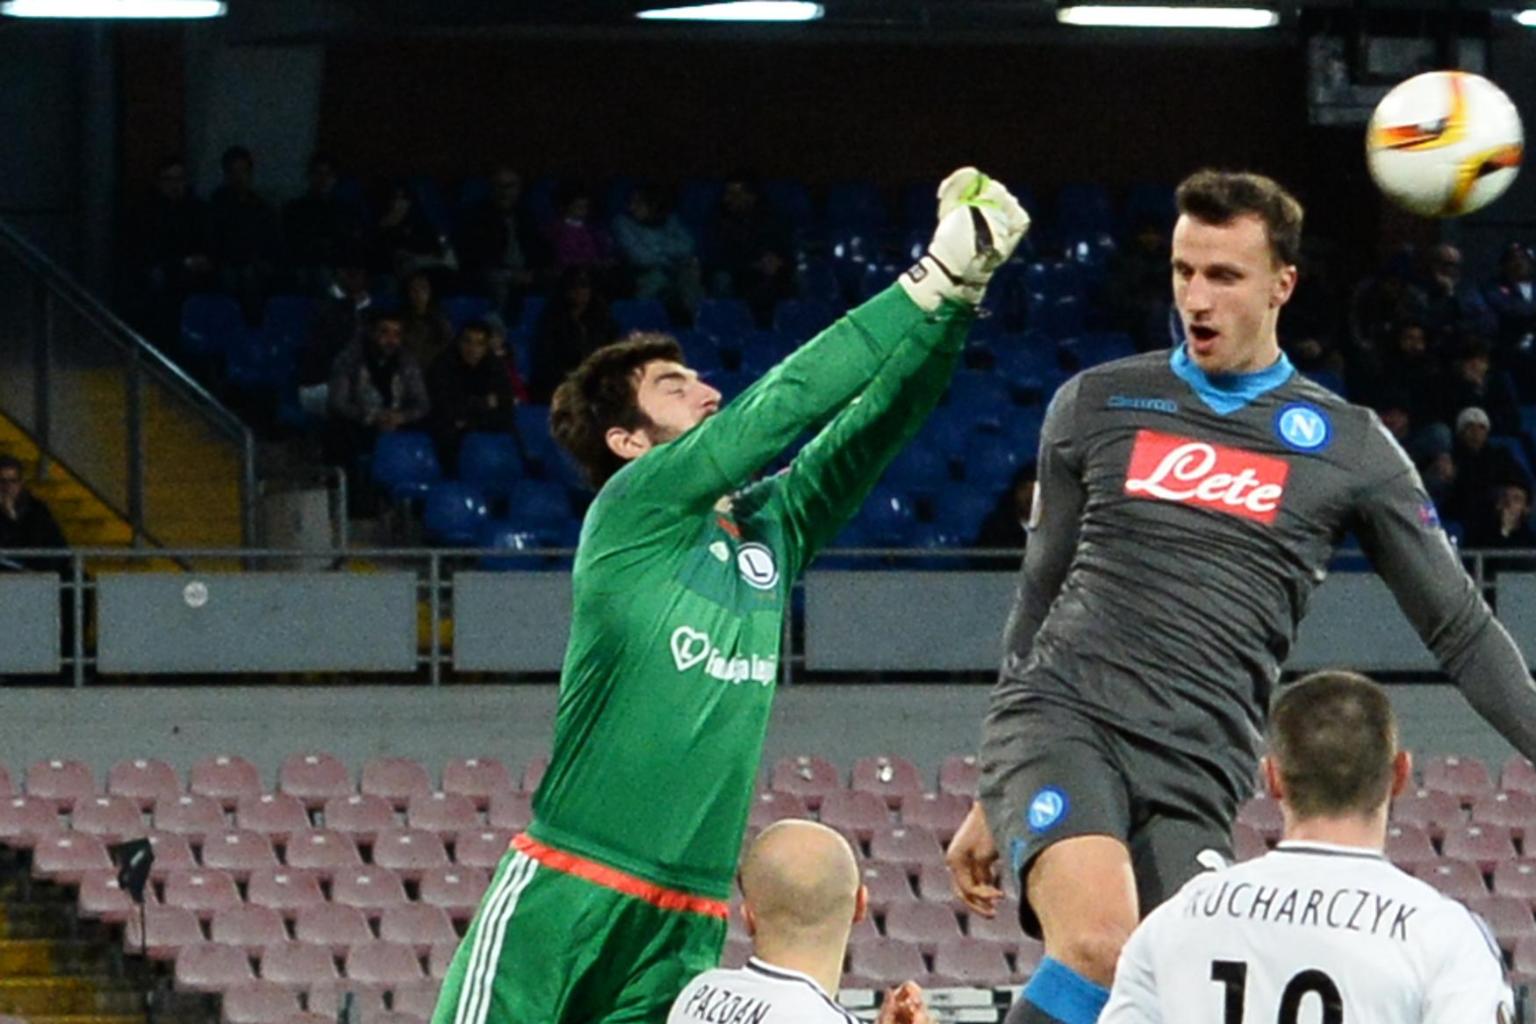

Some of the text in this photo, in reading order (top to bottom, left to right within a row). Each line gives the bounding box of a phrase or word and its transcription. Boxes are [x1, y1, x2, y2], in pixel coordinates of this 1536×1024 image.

[1290, 414, 1318, 440] N
[1124, 442, 1283, 512] Lete
[744, 552, 768, 578] L
